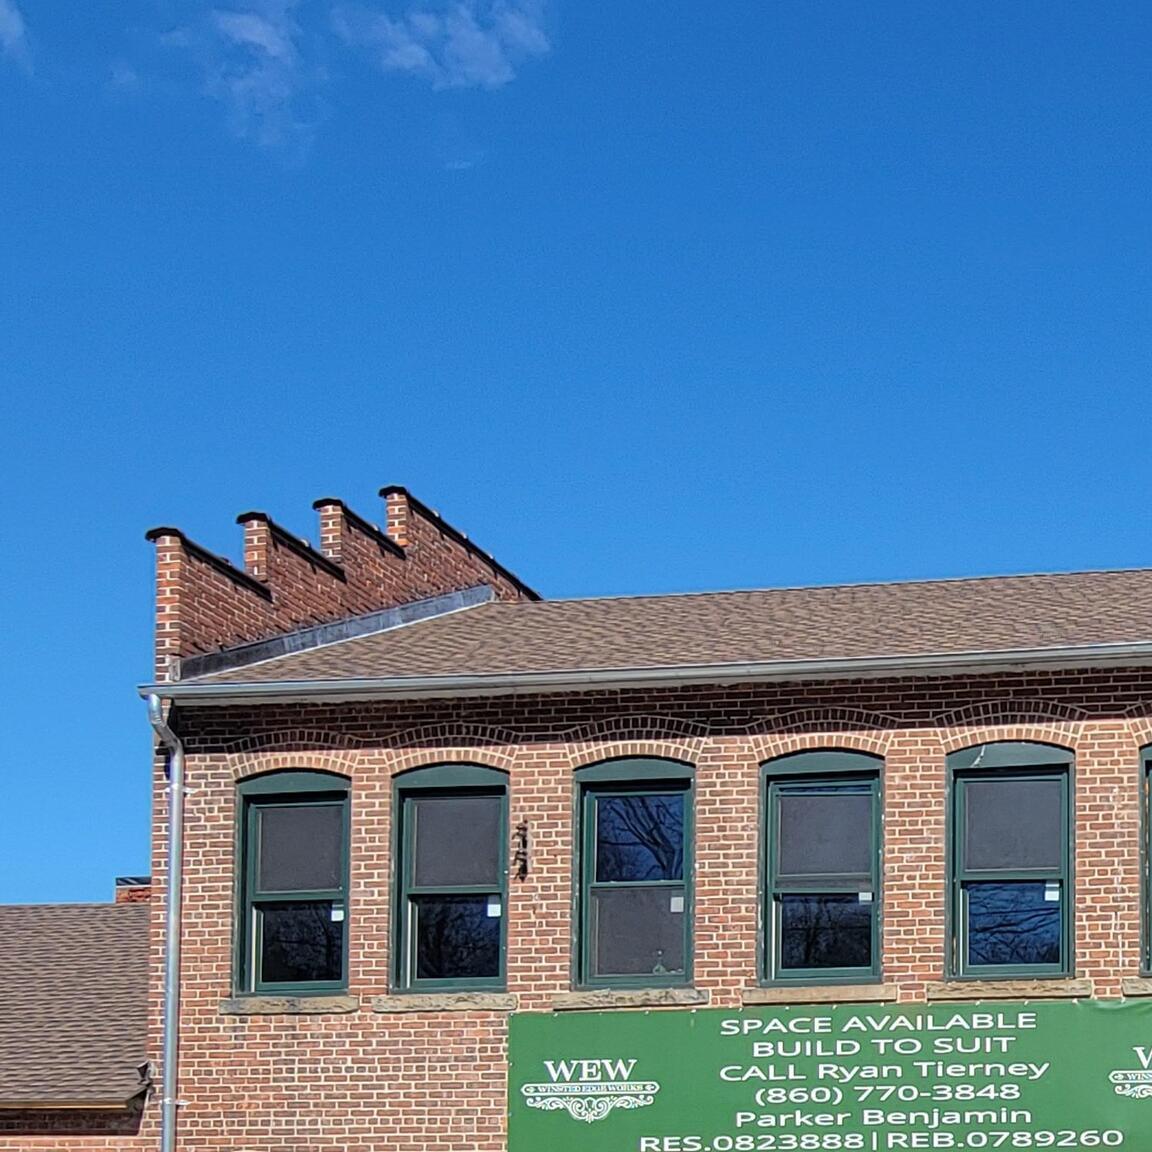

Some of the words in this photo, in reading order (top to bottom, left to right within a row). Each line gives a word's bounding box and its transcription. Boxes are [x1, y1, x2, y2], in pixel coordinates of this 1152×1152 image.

[720, 1016, 833, 1036] SPACE
[840, 1012, 1037, 1033] AVAILABLE
[752, 1039, 861, 1058] BUILD
[870, 1037, 923, 1055] TO
[933, 1036, 1017, 1054] SUIT
[543, 1058, 638, 1083] WEW
[719, 1065, 807, 1082] CALL
[818, 1064, 903, 1083] Ryan
[912, 1061, 1050, 1080] Tierney
[754, 1086, 844, 1107] (860)
[853, 1083, 1021, 1102] 770-3848
[735, 1110, 852, 1128] Parker
[862, 1107, 1033, 1129] Benjamin
[640, 1132, 865, 1152] RES.0823888
[887, 1129, 1124, 1150] REB.0789260
